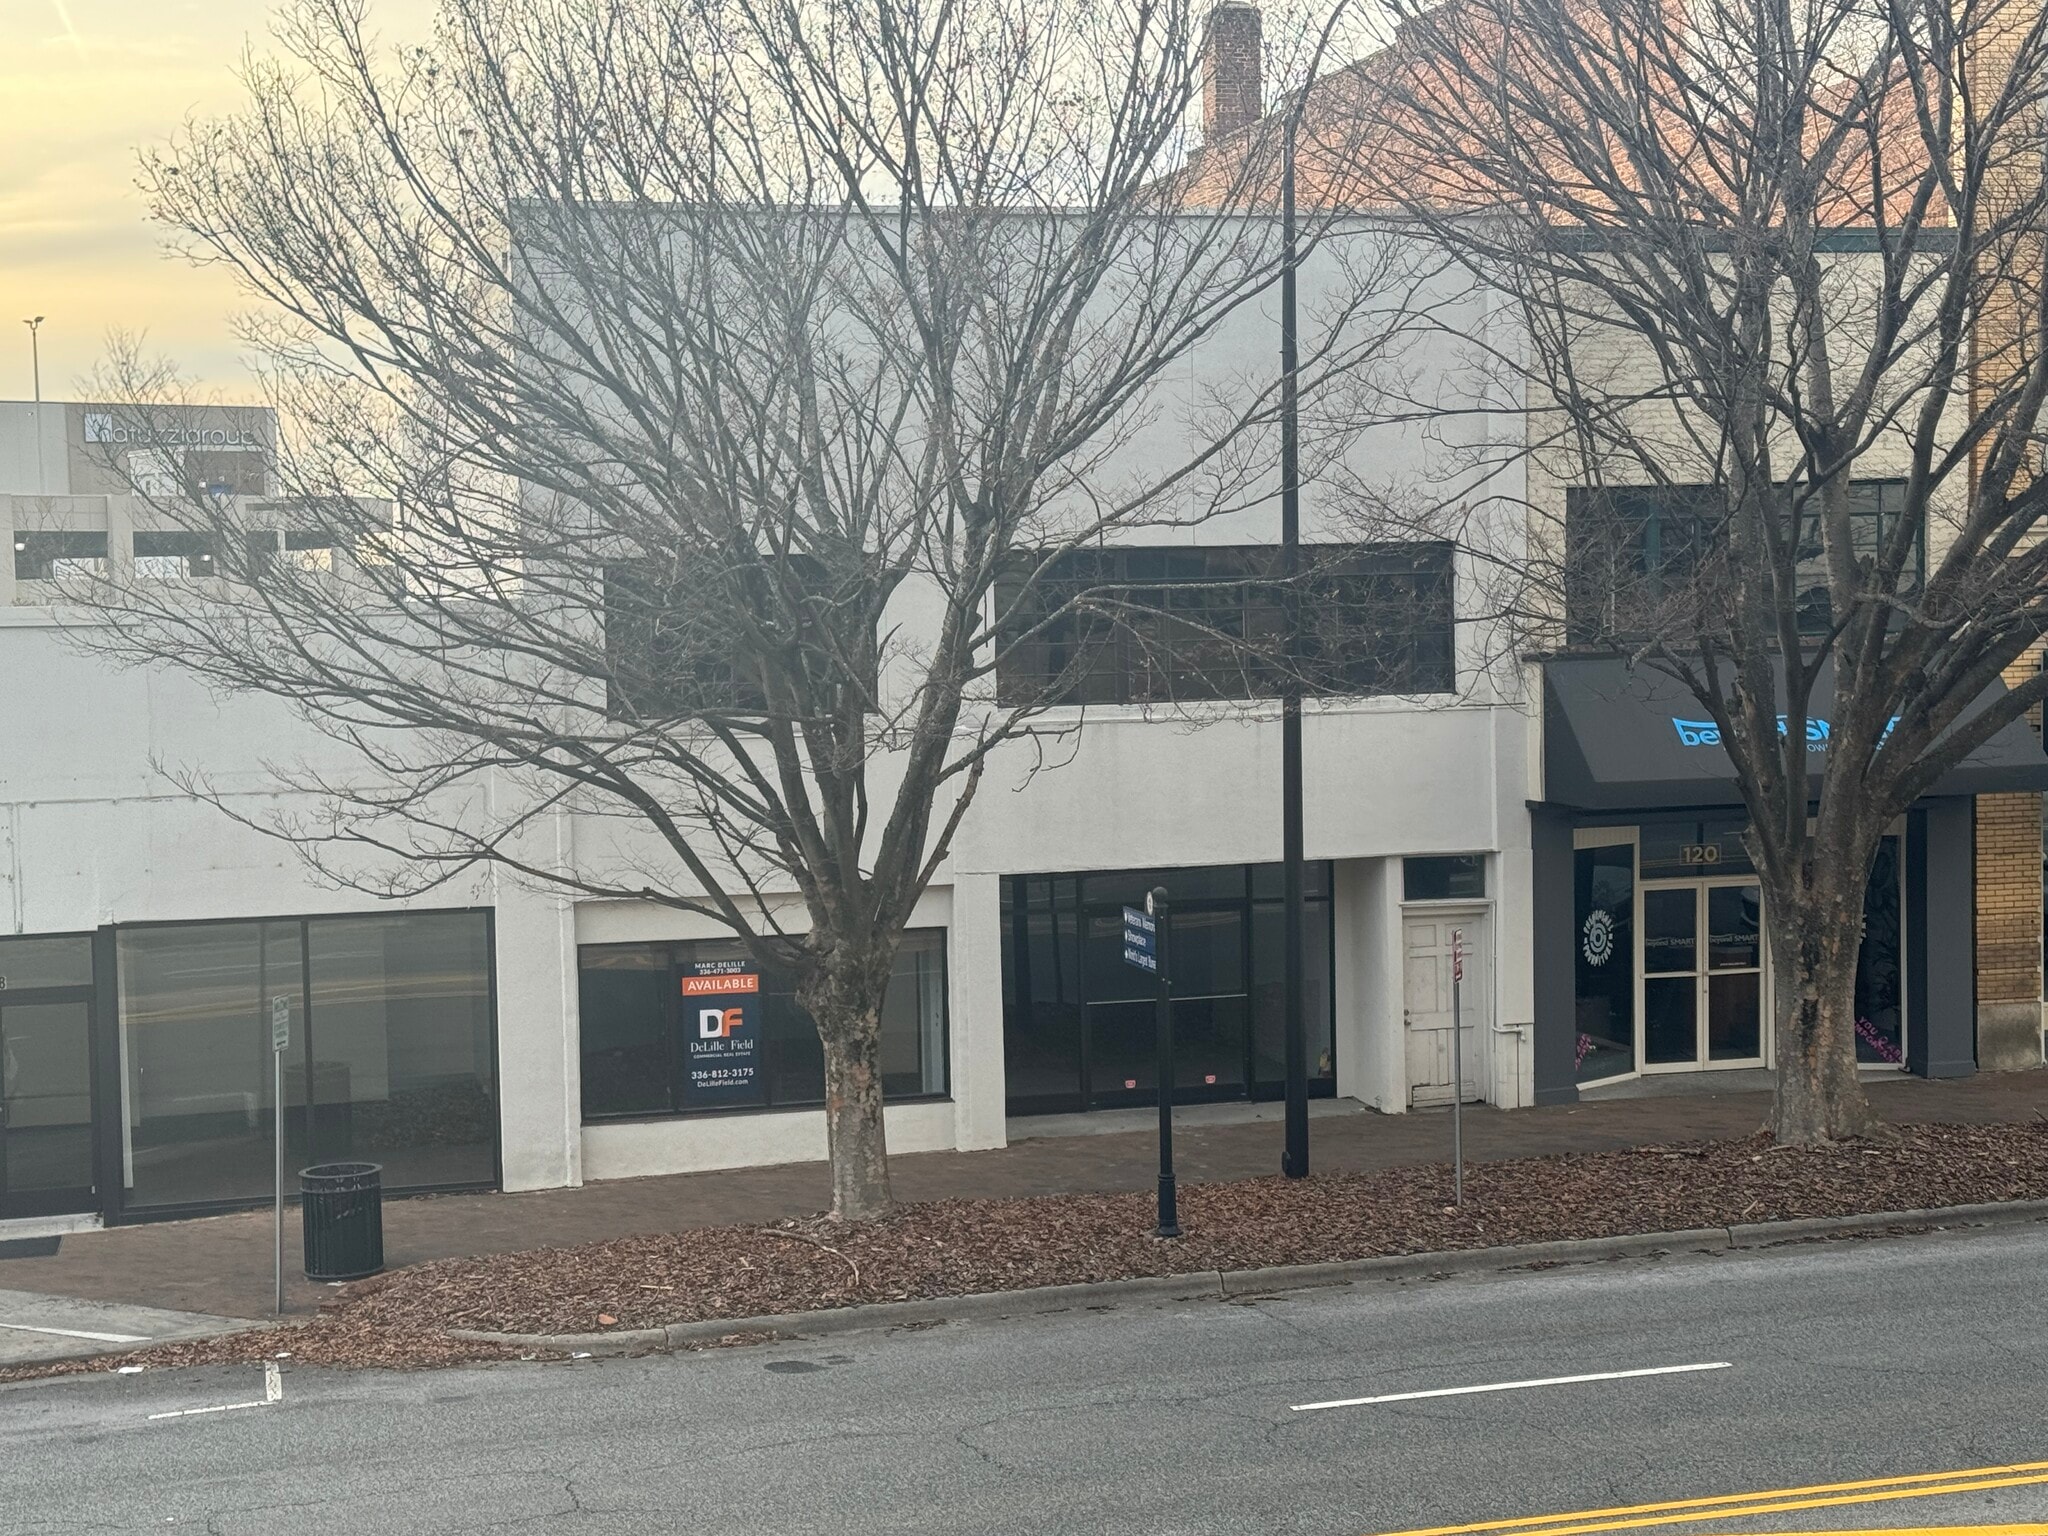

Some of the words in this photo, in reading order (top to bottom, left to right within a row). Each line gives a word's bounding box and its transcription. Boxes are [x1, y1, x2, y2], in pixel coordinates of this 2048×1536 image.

[1683, 846, 1717, 863] 120
[1670, 937, 1695, 946] SMART
[1734, 934, 1759, 942] SMART
[687, 977, 754, 991] AVAILABLE
[699, 1008, 743, 1039] DF
[690, 1041, 725, 1053] DeLille
[730, 1039, 754, 1051] Field
[691, 1067, 754, 1080] 336-812-3175
[697, 1079, 749, 1088] DeLilleField.com
